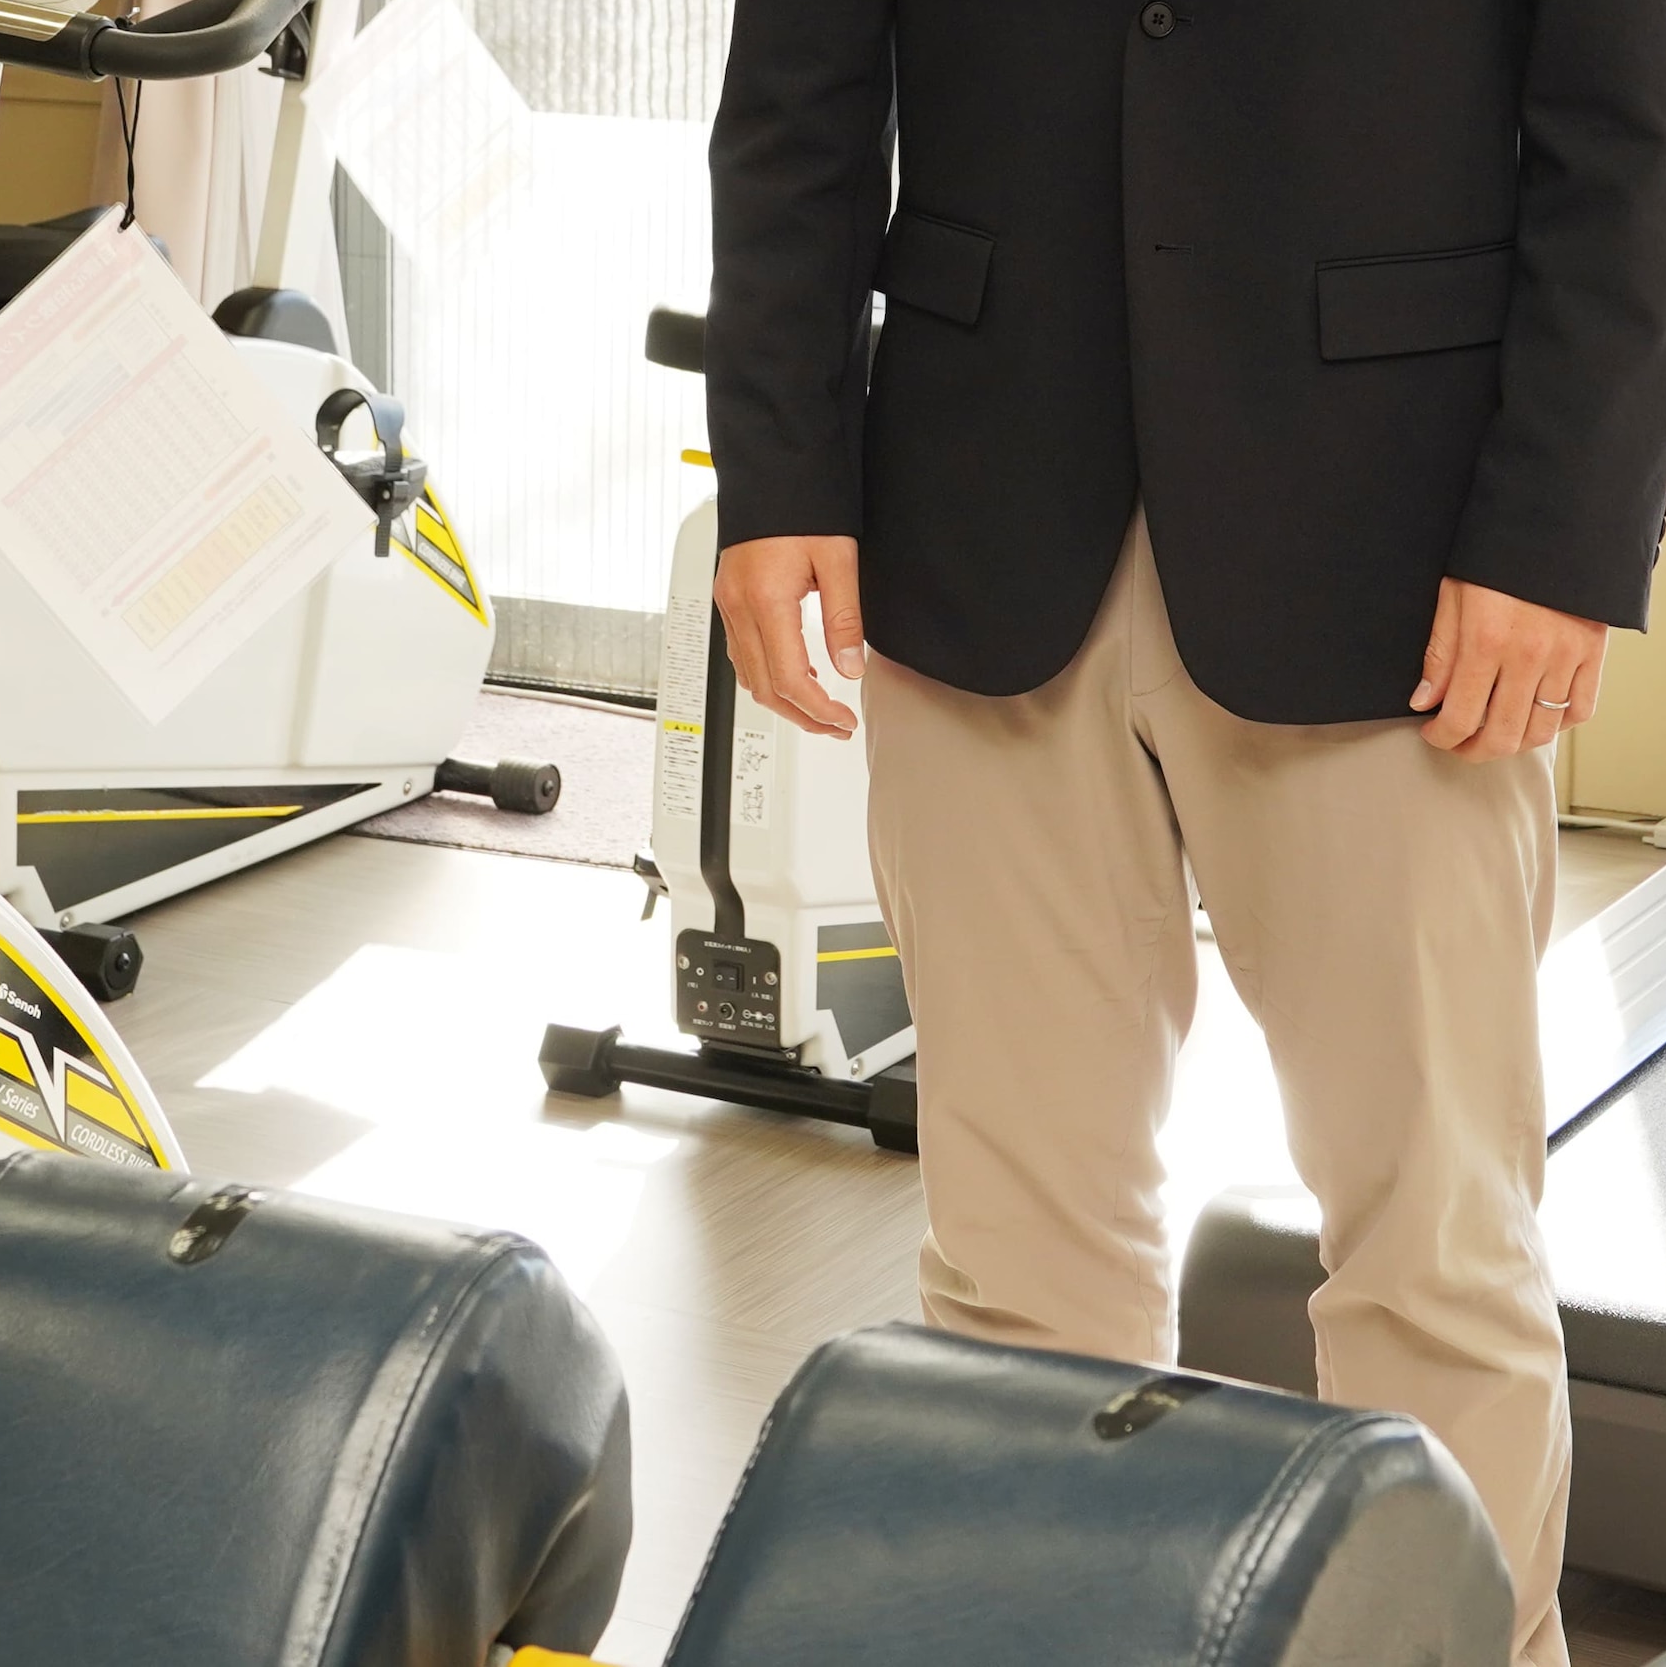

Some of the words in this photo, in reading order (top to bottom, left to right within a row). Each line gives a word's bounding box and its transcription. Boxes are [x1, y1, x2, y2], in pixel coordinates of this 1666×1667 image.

[6, 990, 42, 1020] Senoh
[1, 1087, 40, 1119] Series
[70, 1123, 127, 1164] CORDLESS
